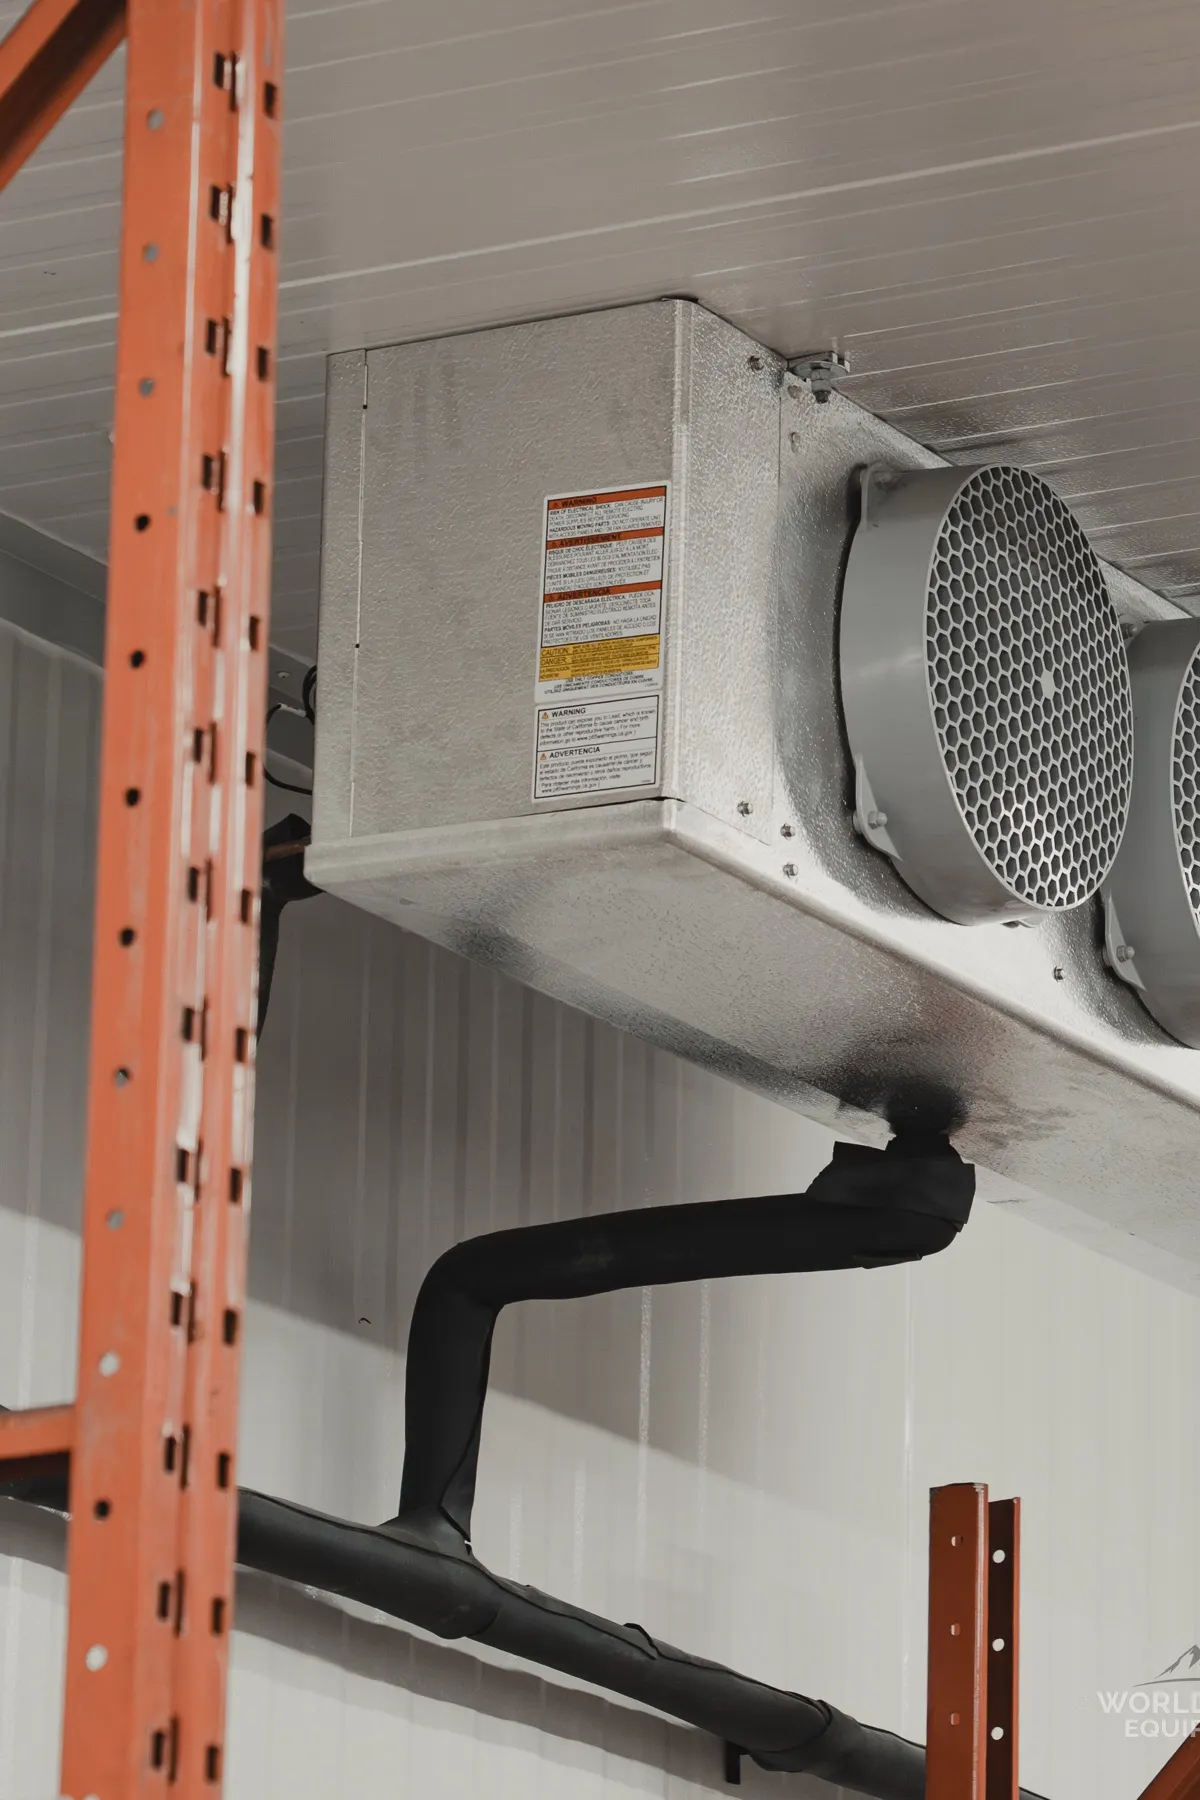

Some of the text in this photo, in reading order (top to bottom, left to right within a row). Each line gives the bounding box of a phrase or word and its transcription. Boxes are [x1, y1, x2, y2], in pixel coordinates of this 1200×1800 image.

[561, 497, 597, 508] WARNING
[560, 533, 620, 548] AVERTISSEMENT
[558, 587, 610, 601] ADVERTENCIA
[551, 707, 586, 718] WARNING
[549, 746, 601, 759] ADVERTENCIA
